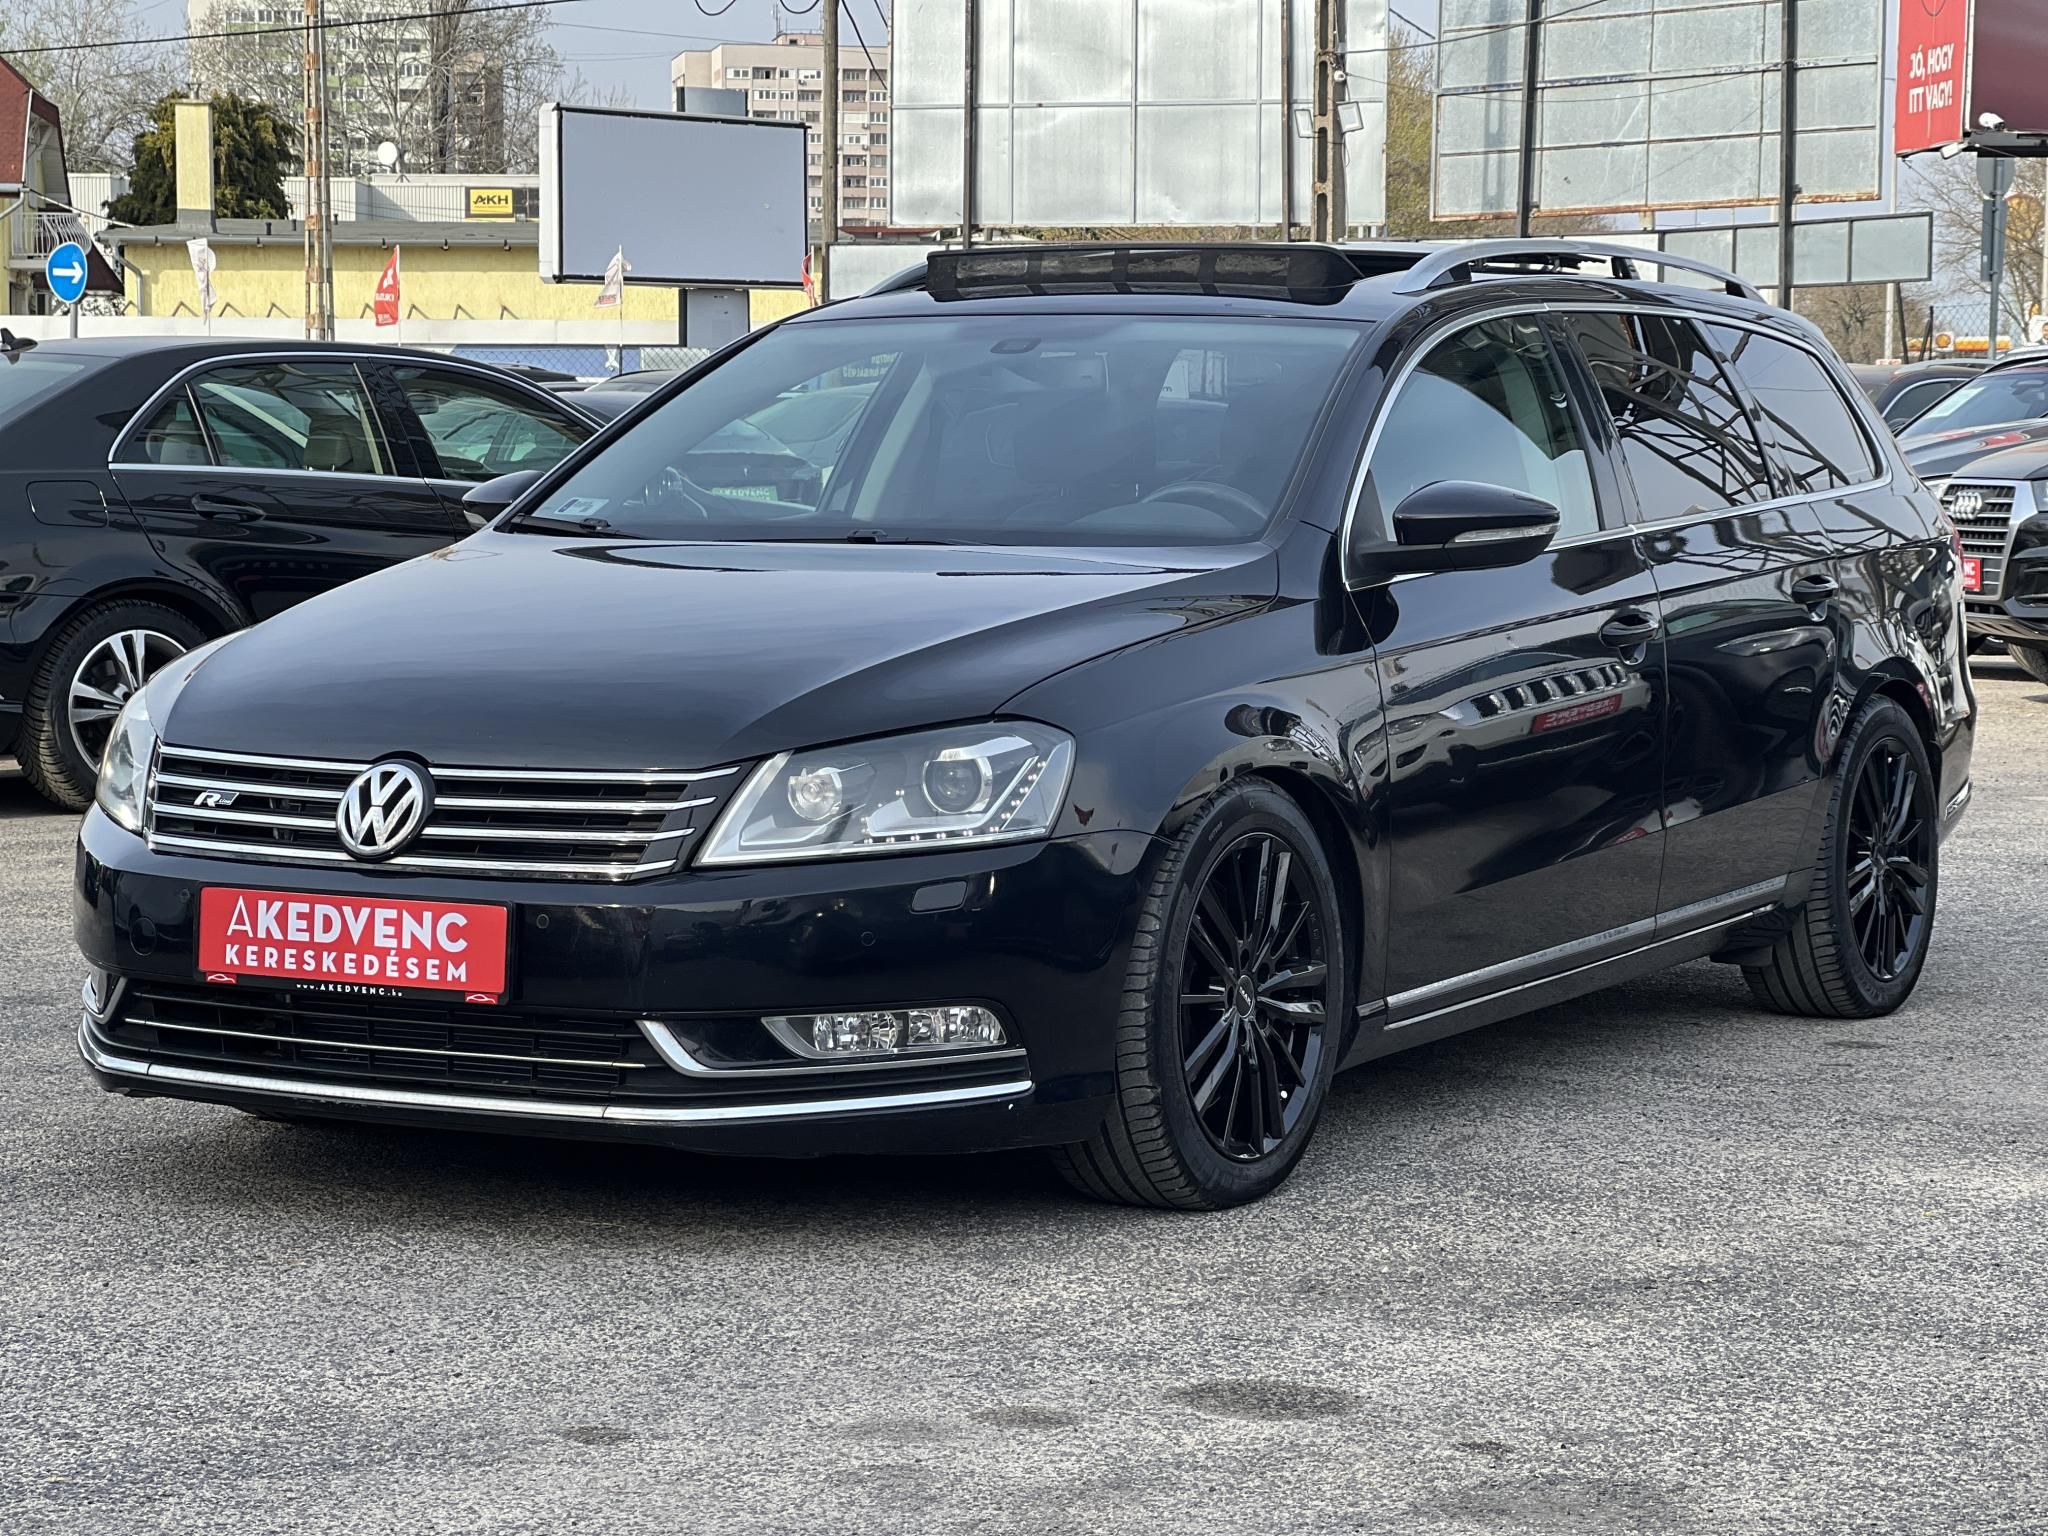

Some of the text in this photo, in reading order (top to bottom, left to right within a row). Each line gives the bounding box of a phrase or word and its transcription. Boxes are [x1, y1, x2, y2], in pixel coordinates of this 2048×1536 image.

[1909, 43, 1955, 81] JÓ, HOGY
[1908, 79, 1953, 114] ITT VAGY!
[472, 194, 509, 205] AKH
[226, 895, 469, 953] AKEDVENC
[225, 943, 468, 983] KERESKEDÉSEM
